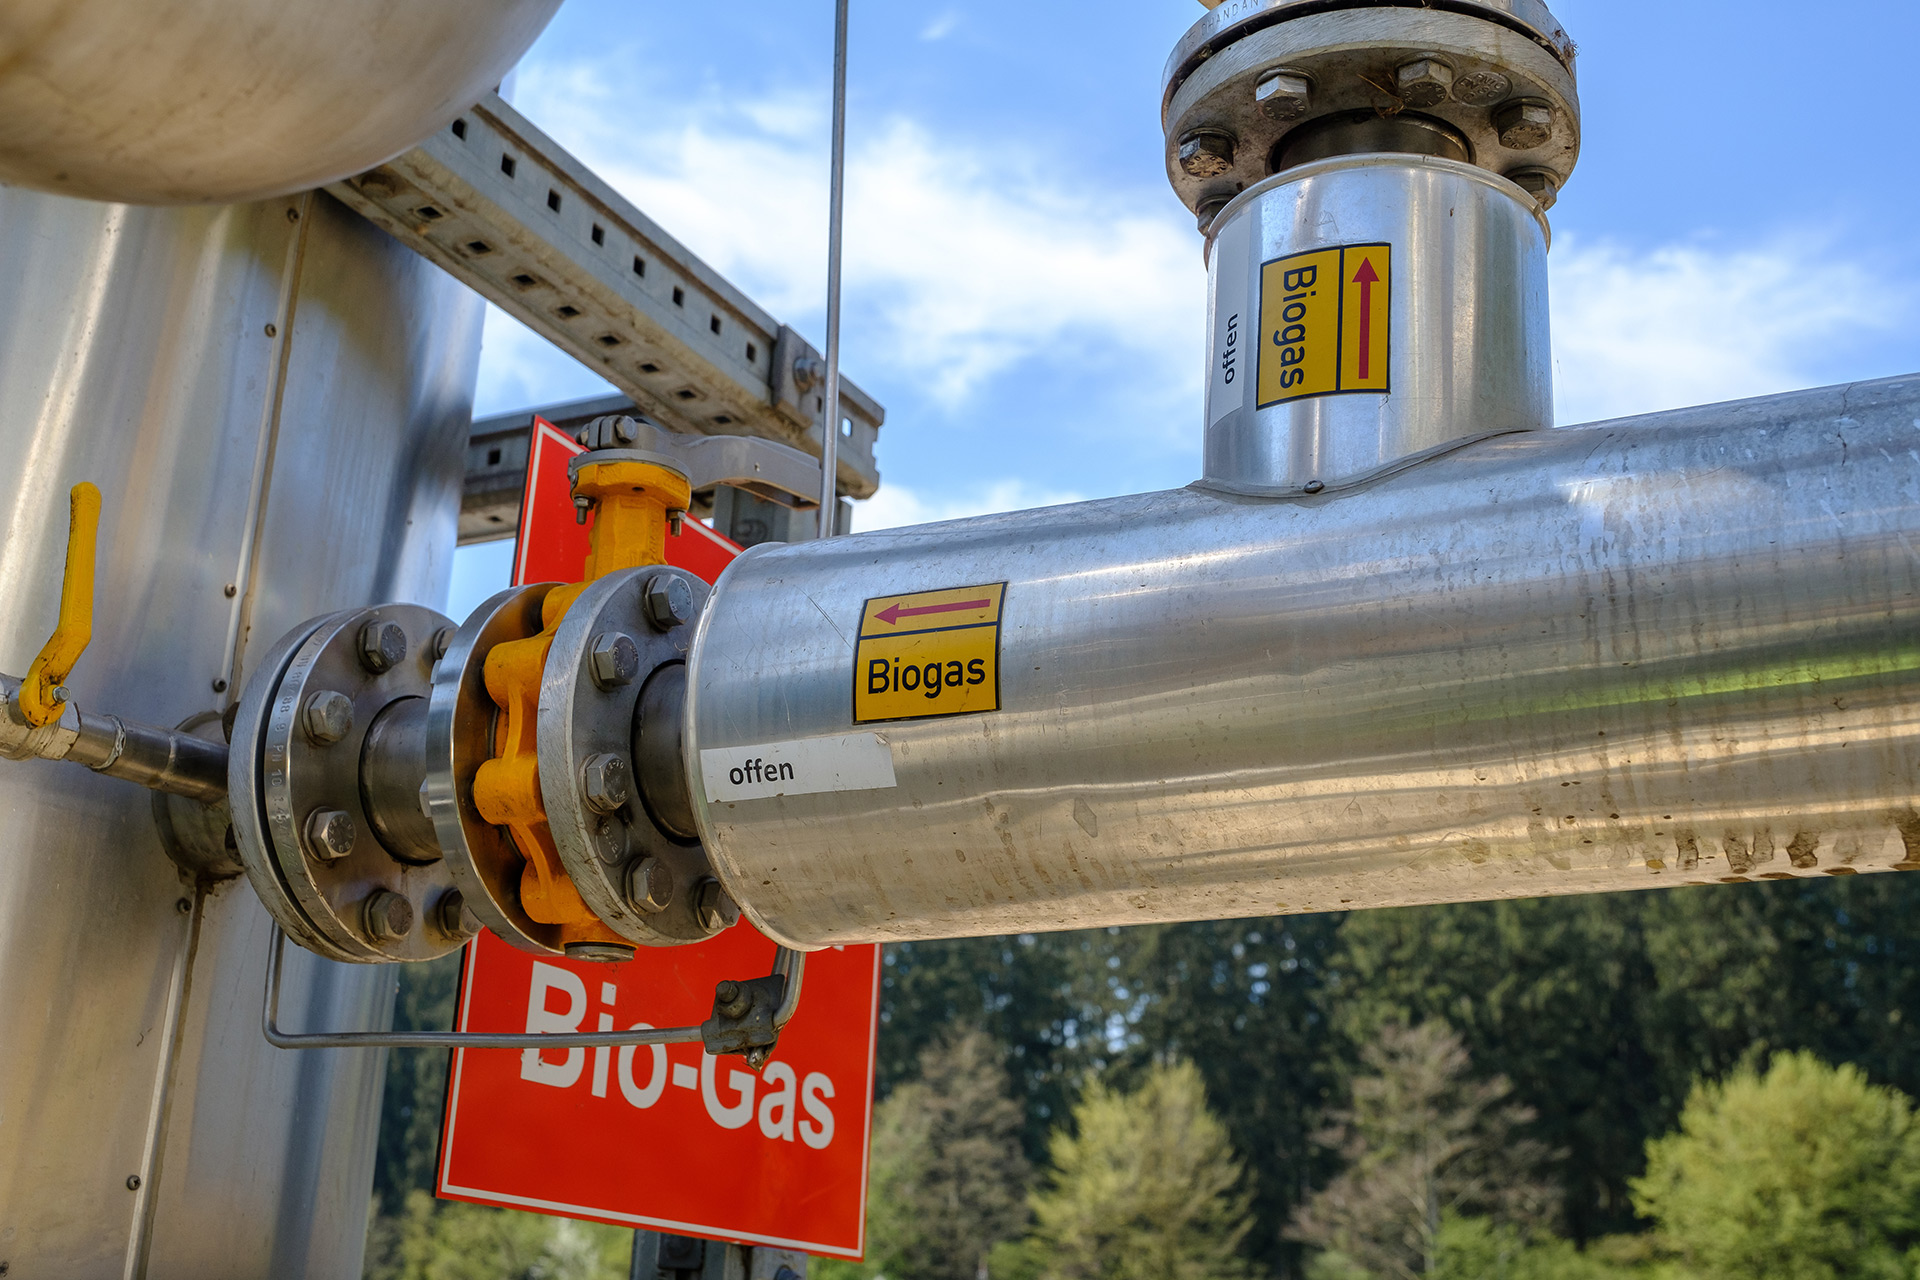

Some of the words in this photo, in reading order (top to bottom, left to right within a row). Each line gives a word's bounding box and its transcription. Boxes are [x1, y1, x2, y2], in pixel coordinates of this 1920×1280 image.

[1222, 313, 1239, 385] offen
[1272, 264, 1318, 389] Biogas
[867, 656, 986, 700] Biogas
[729, 757, 795, 786] offen
[520, 961, 836, 1150] Bio-Gas
